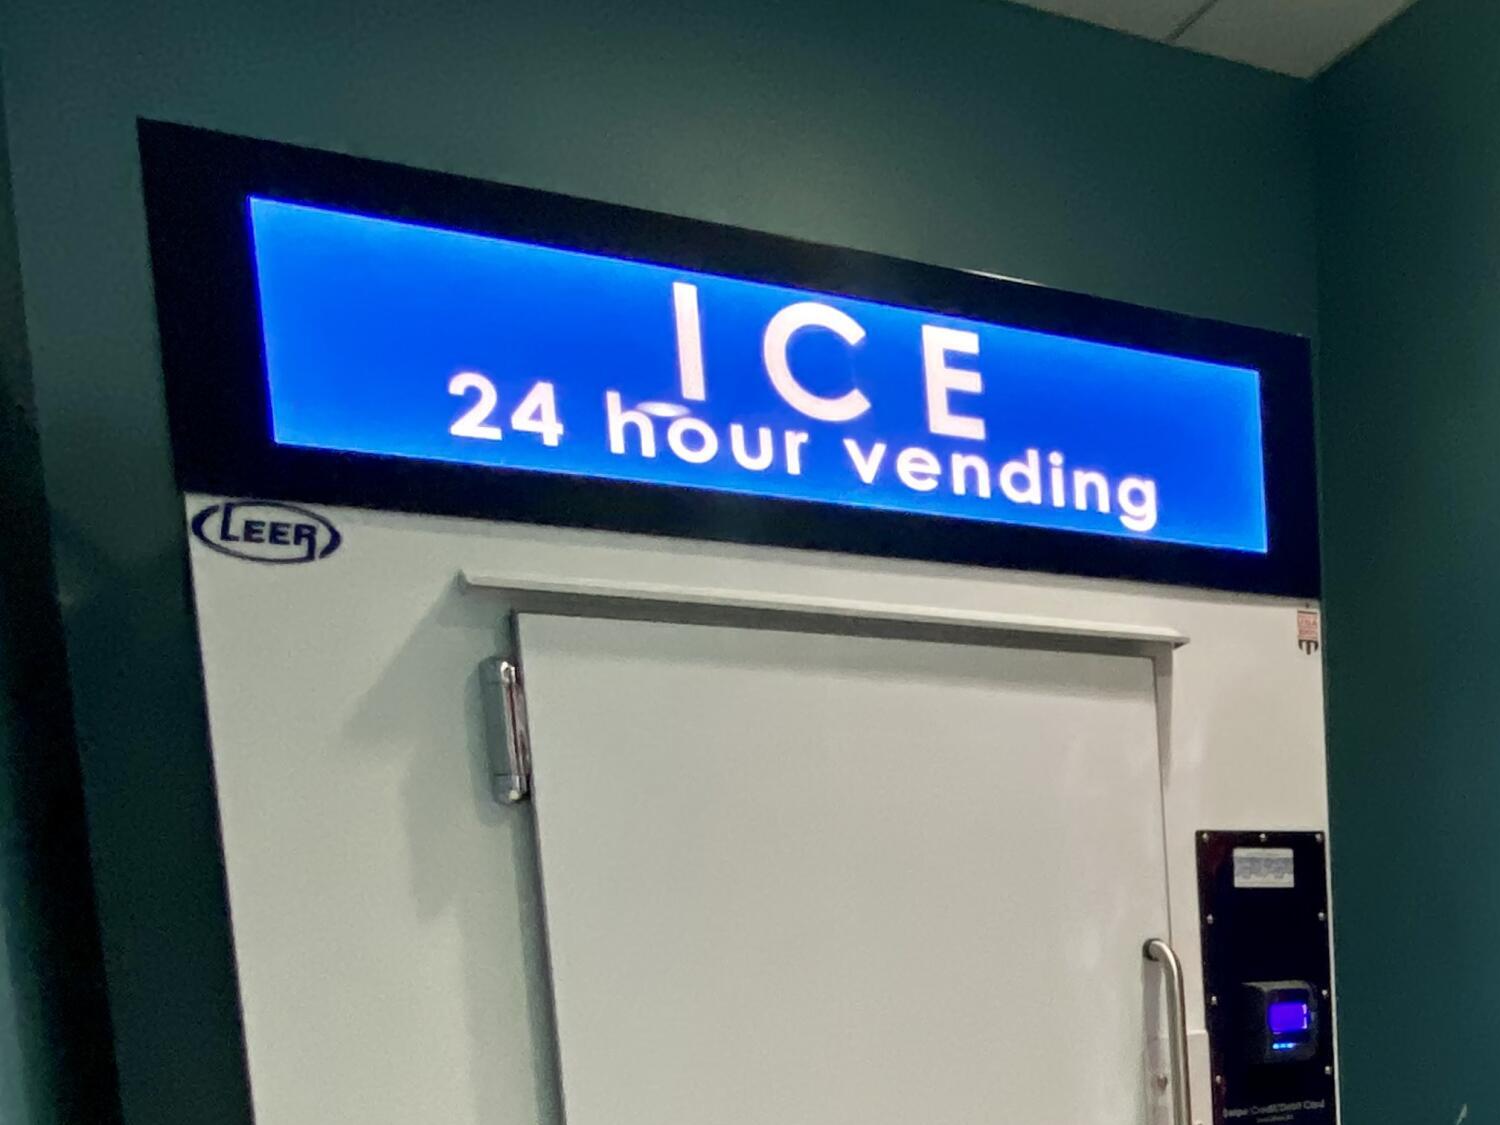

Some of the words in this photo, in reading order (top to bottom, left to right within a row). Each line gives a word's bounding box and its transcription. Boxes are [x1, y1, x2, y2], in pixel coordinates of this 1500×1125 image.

[672, 281, 987, 440] ICE
[220, 502, 316, 561] LEER
[447, 372, 565, 448] 24
[606, 390, 807, 479] hour
[843, 440, 1160, 533] vending
